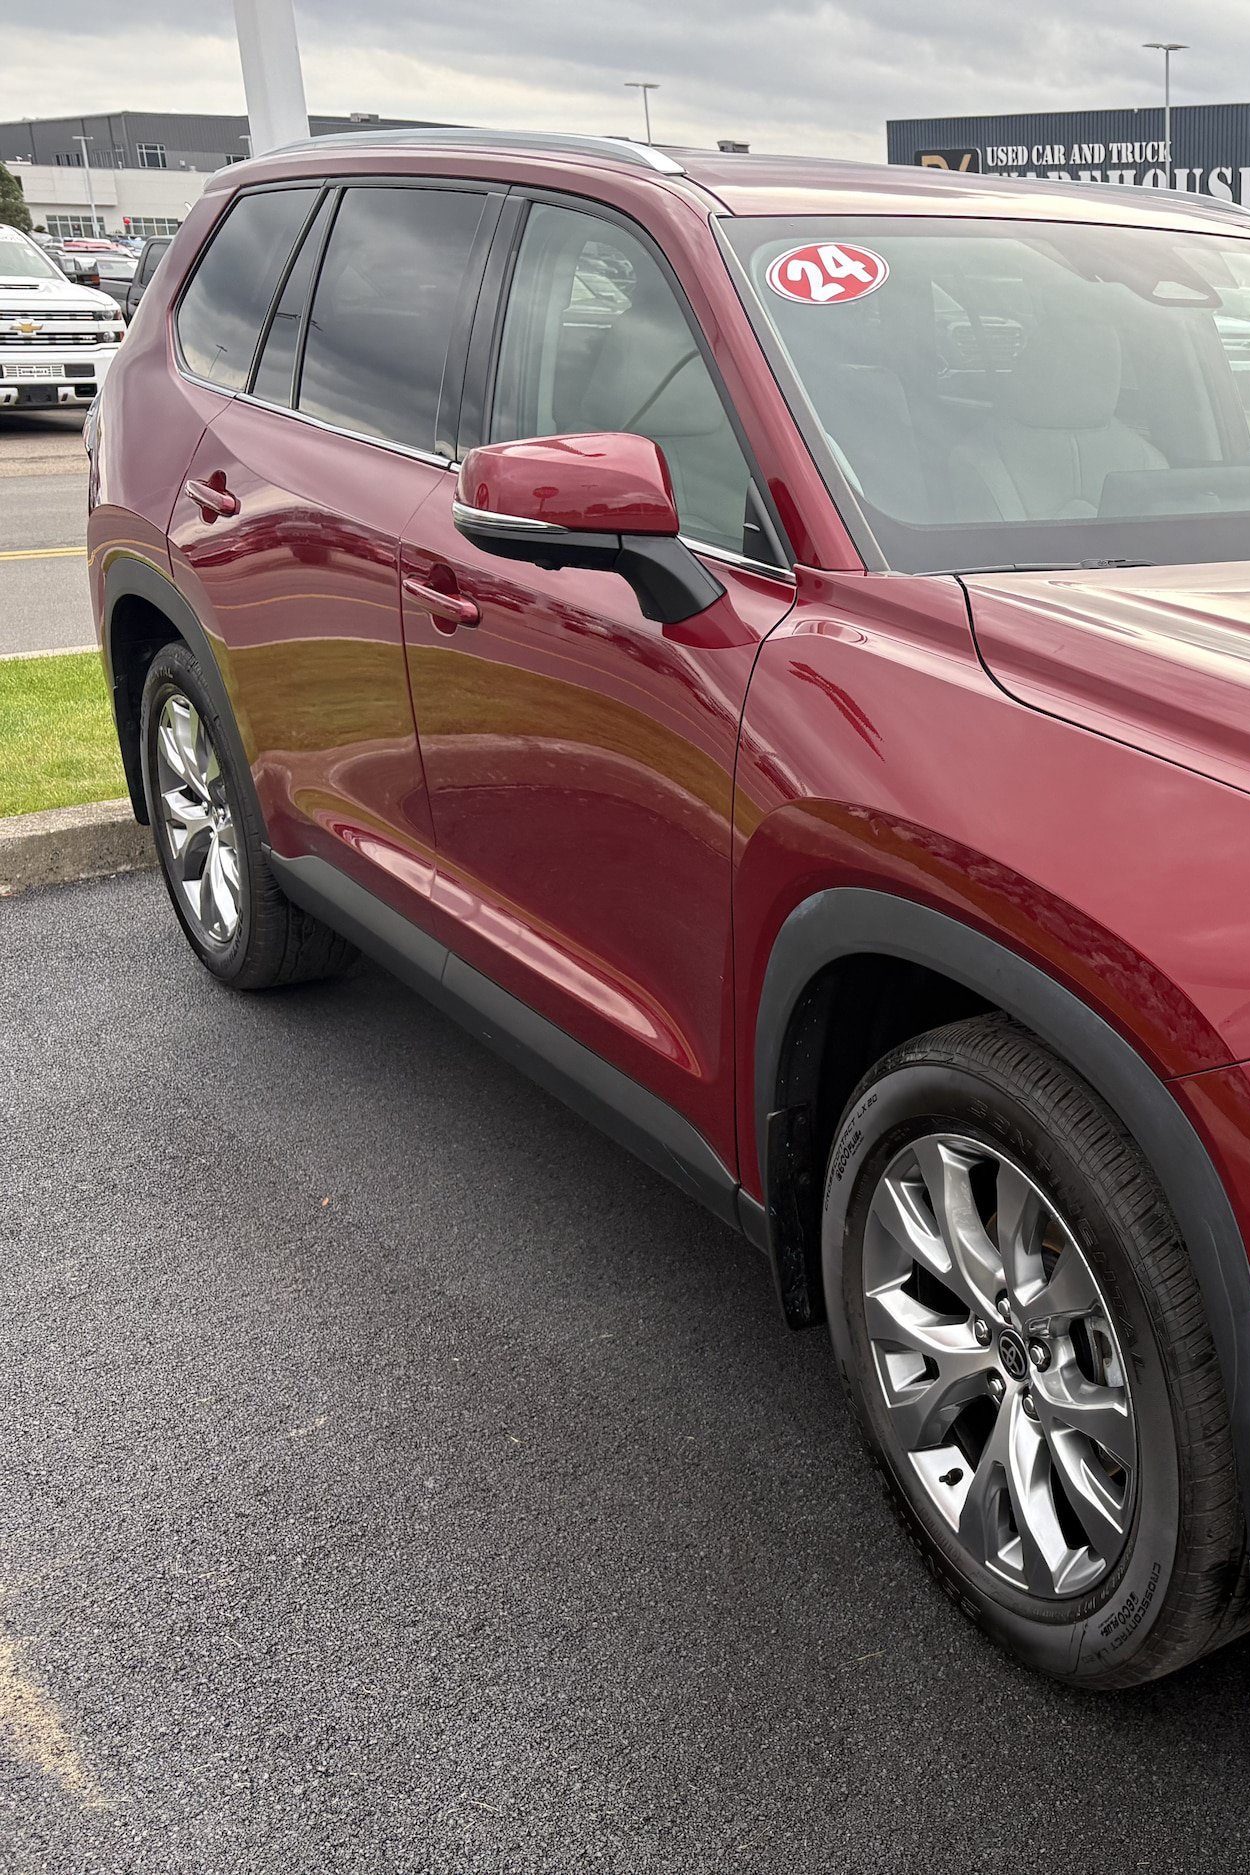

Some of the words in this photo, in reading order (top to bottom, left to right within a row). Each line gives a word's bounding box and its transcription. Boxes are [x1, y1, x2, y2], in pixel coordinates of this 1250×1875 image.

[986, 146, 1028, 167] USED
[1032, 144, 1066, 166] CAR
[1069, 143, 1106, 164] AND
[1109, 141, 1172, 163] TRUCK
[786, 245, 874, 302] 24
